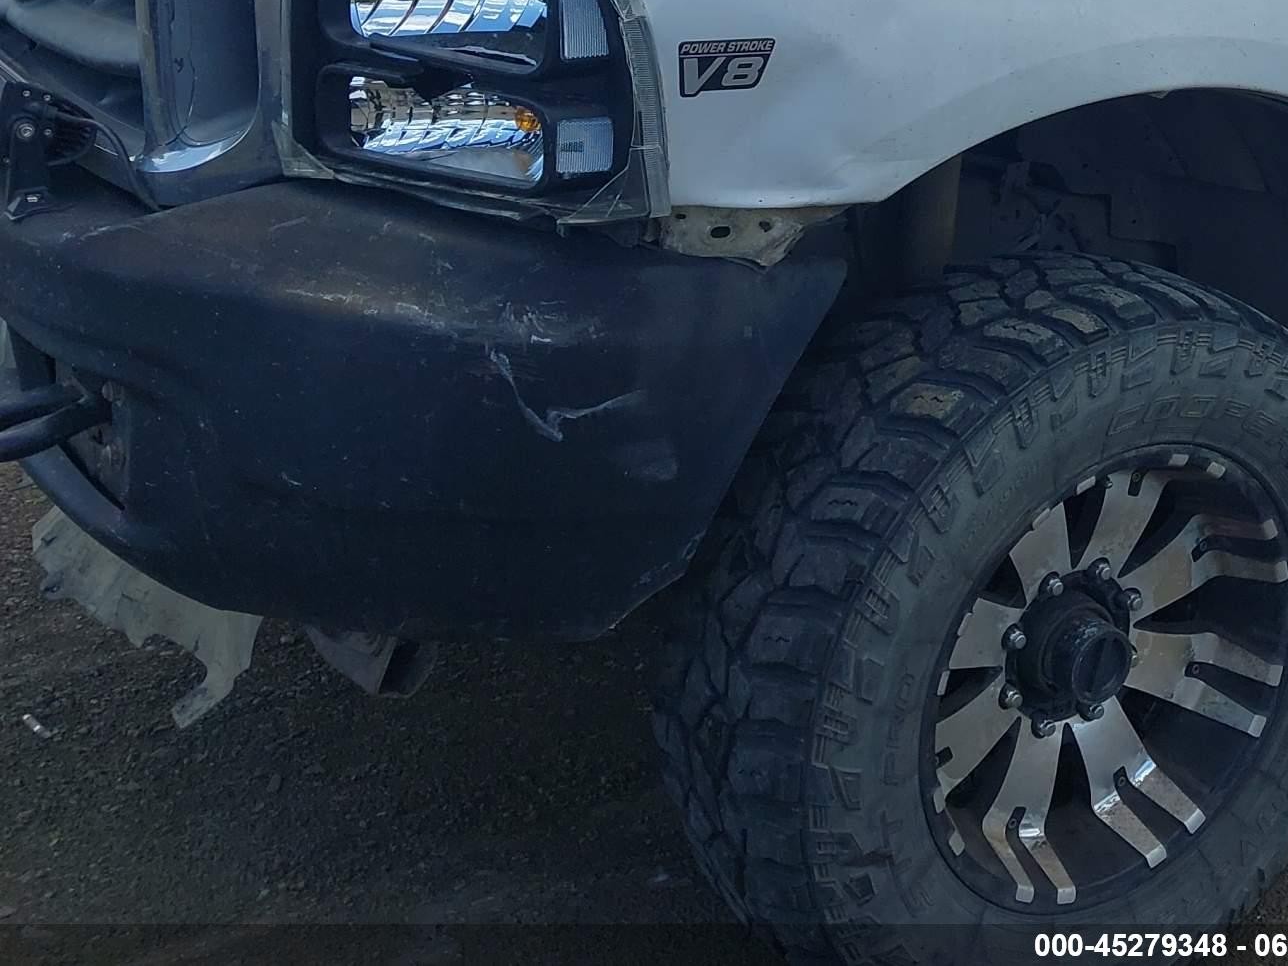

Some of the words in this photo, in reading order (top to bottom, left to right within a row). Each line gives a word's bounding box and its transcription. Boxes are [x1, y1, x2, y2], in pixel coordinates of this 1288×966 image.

[680, 42, 726, 54] POWER
[727, 40, 774, 52] STROKE
[683, 56, 764, 95] V8
